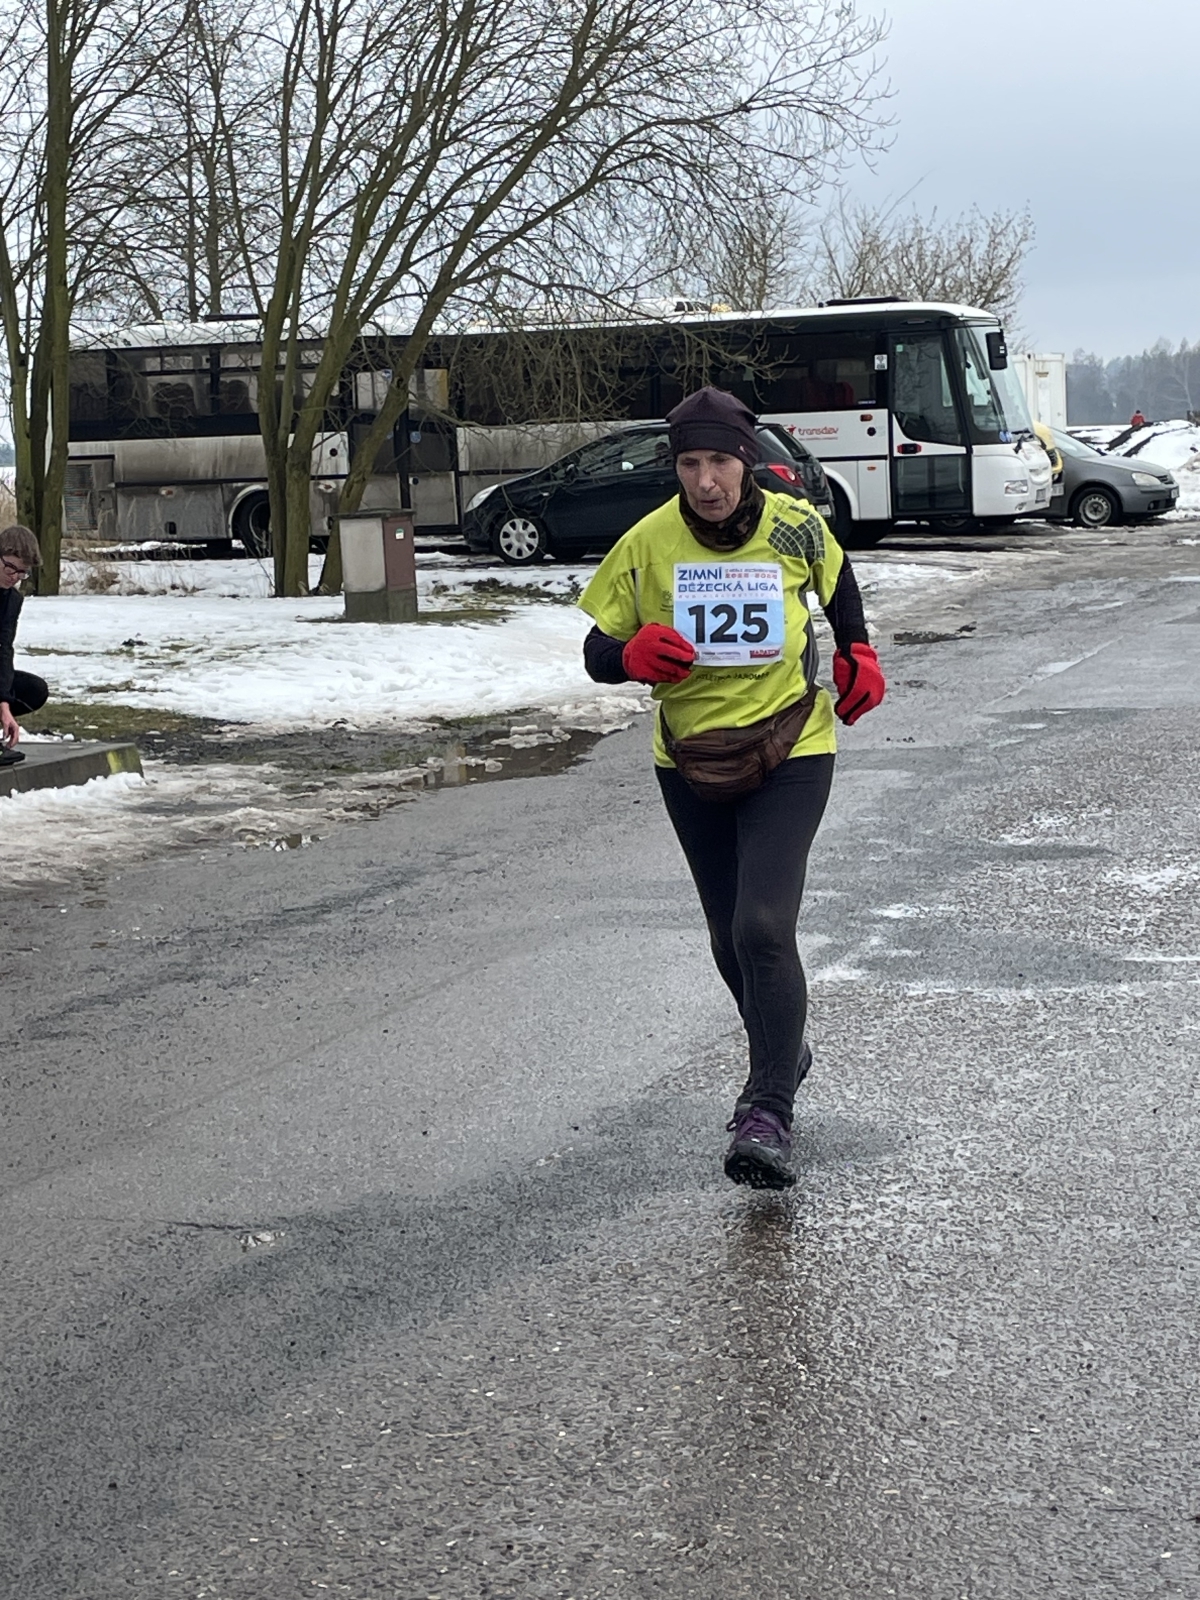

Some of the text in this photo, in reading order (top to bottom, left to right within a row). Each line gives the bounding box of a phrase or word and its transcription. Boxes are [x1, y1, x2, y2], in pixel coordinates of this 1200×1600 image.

[798, 426, 839, 436] transdev
[678, 567, 722, 580] ZIMNÍ
[677, 581, 778, 593] BĚŽECKÁ LIGA
[688, 604, 769, 643] 125
